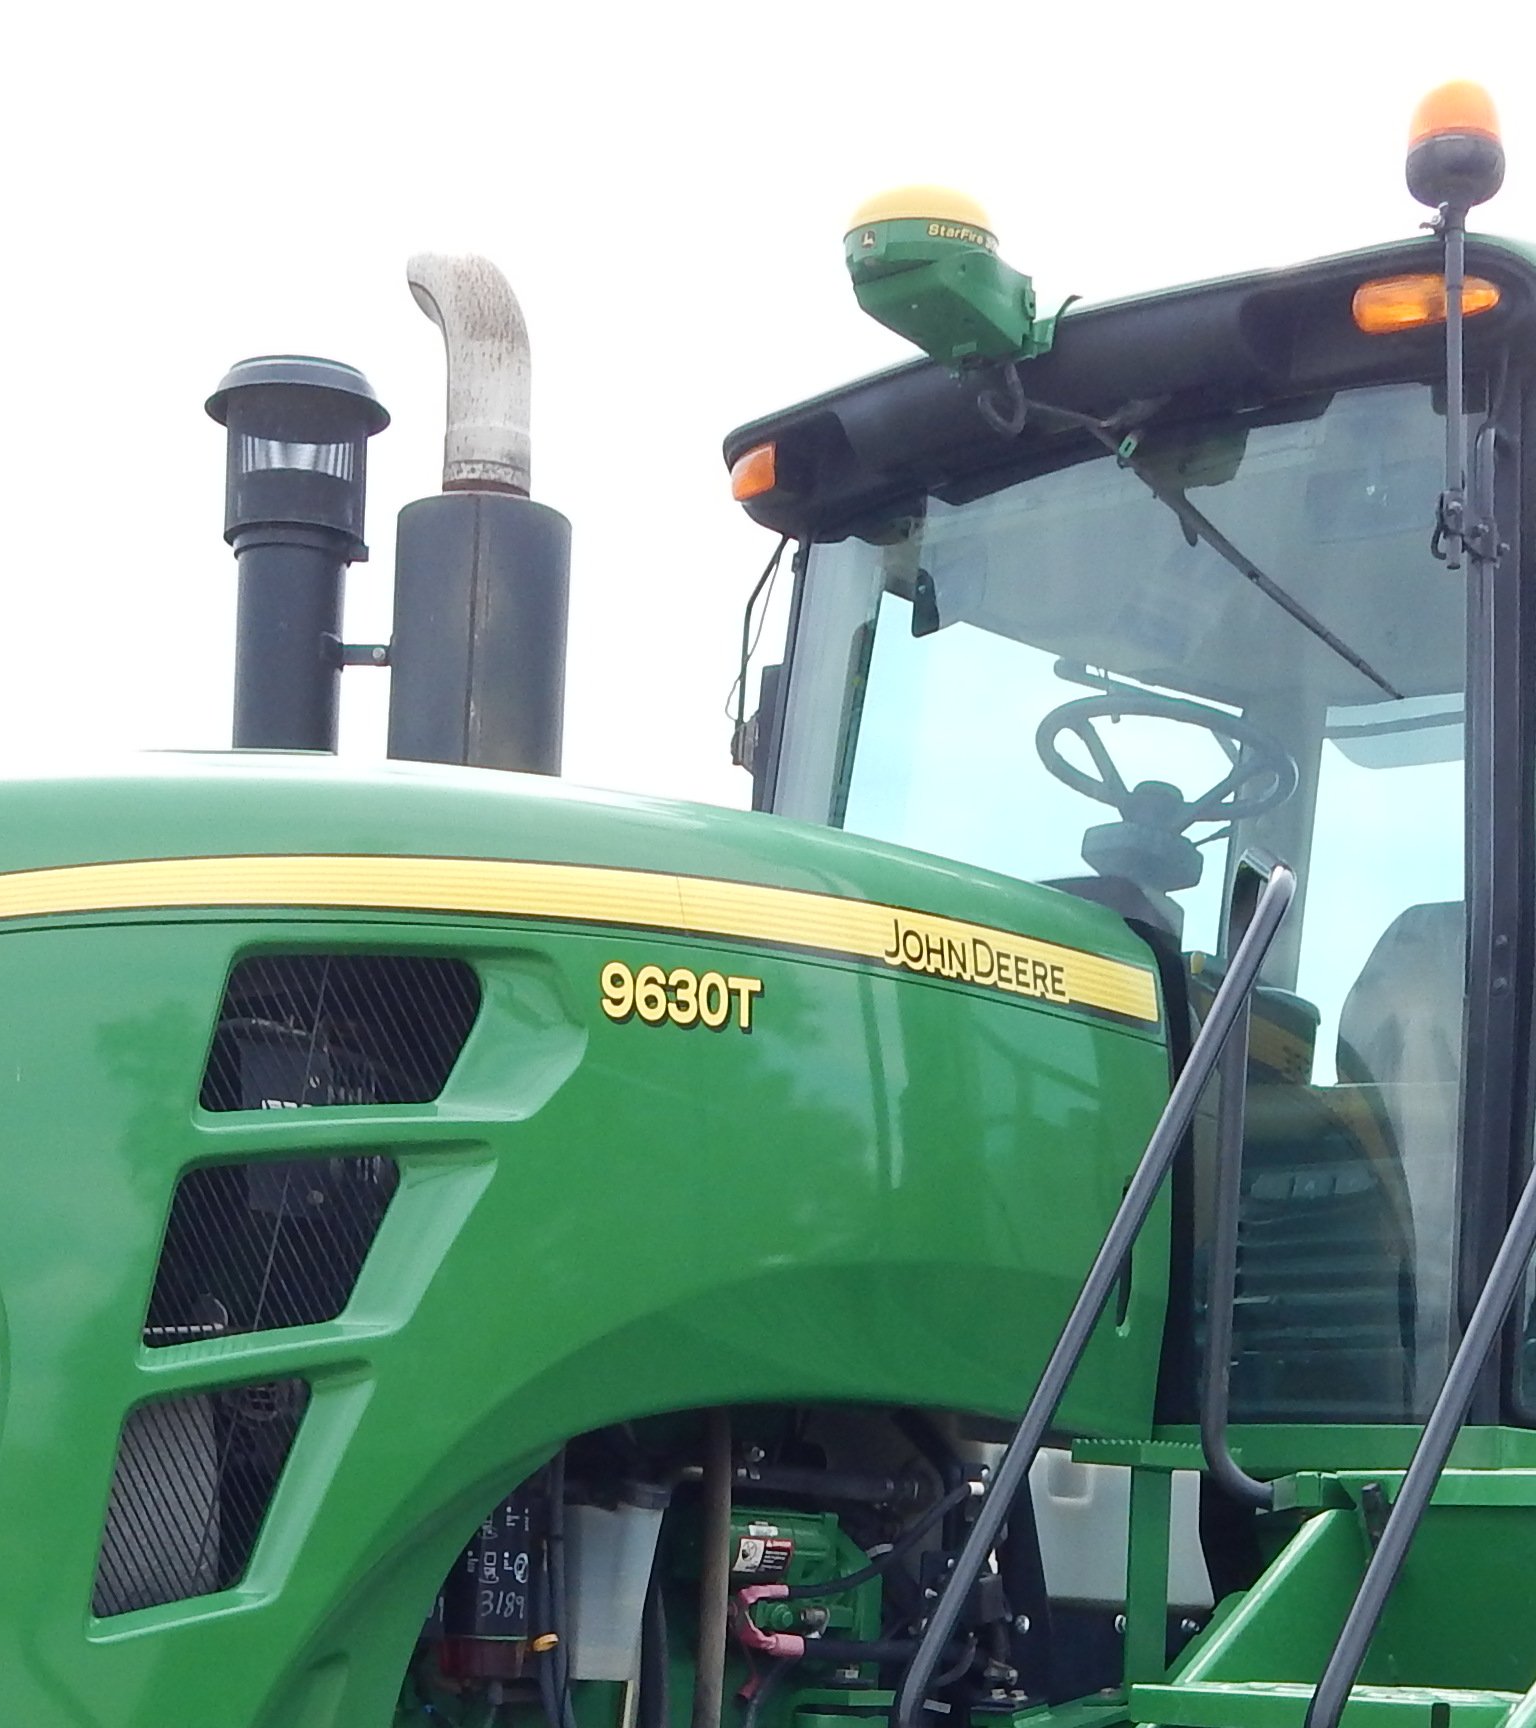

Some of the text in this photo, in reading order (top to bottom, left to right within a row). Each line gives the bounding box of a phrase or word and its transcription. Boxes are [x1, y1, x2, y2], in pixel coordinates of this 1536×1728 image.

[928, 223, 984, 246] StarFire
[885, 919, 1065, 996] JOHN DEERE
[600, 961, 762, 1030] 9630T
[480, 1590, 525, 1620] 3189
